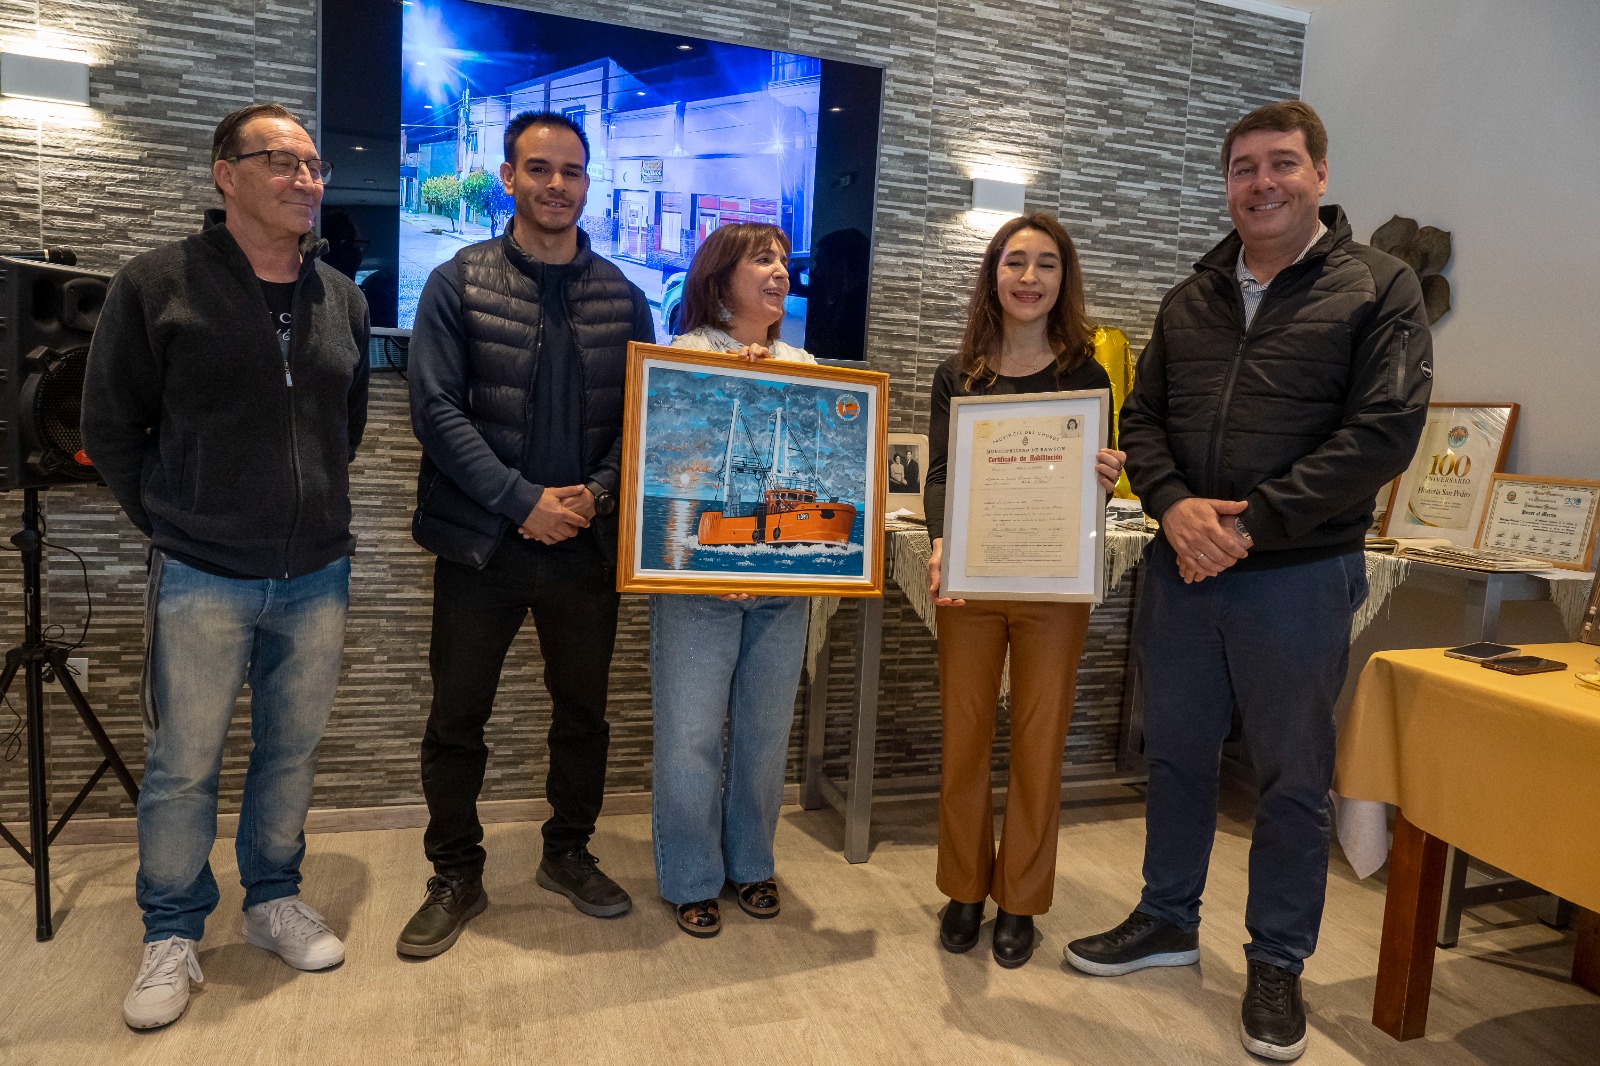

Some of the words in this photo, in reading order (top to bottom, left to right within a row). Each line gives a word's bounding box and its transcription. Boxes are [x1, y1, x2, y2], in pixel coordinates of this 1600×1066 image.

[1429, 453, 1471, 478] 100
[1424, 476, 1471, 485] ANIVERSARIO
[1441, 488, 1453, 497] San
[1453, 489, 1471, 498] Pedro
